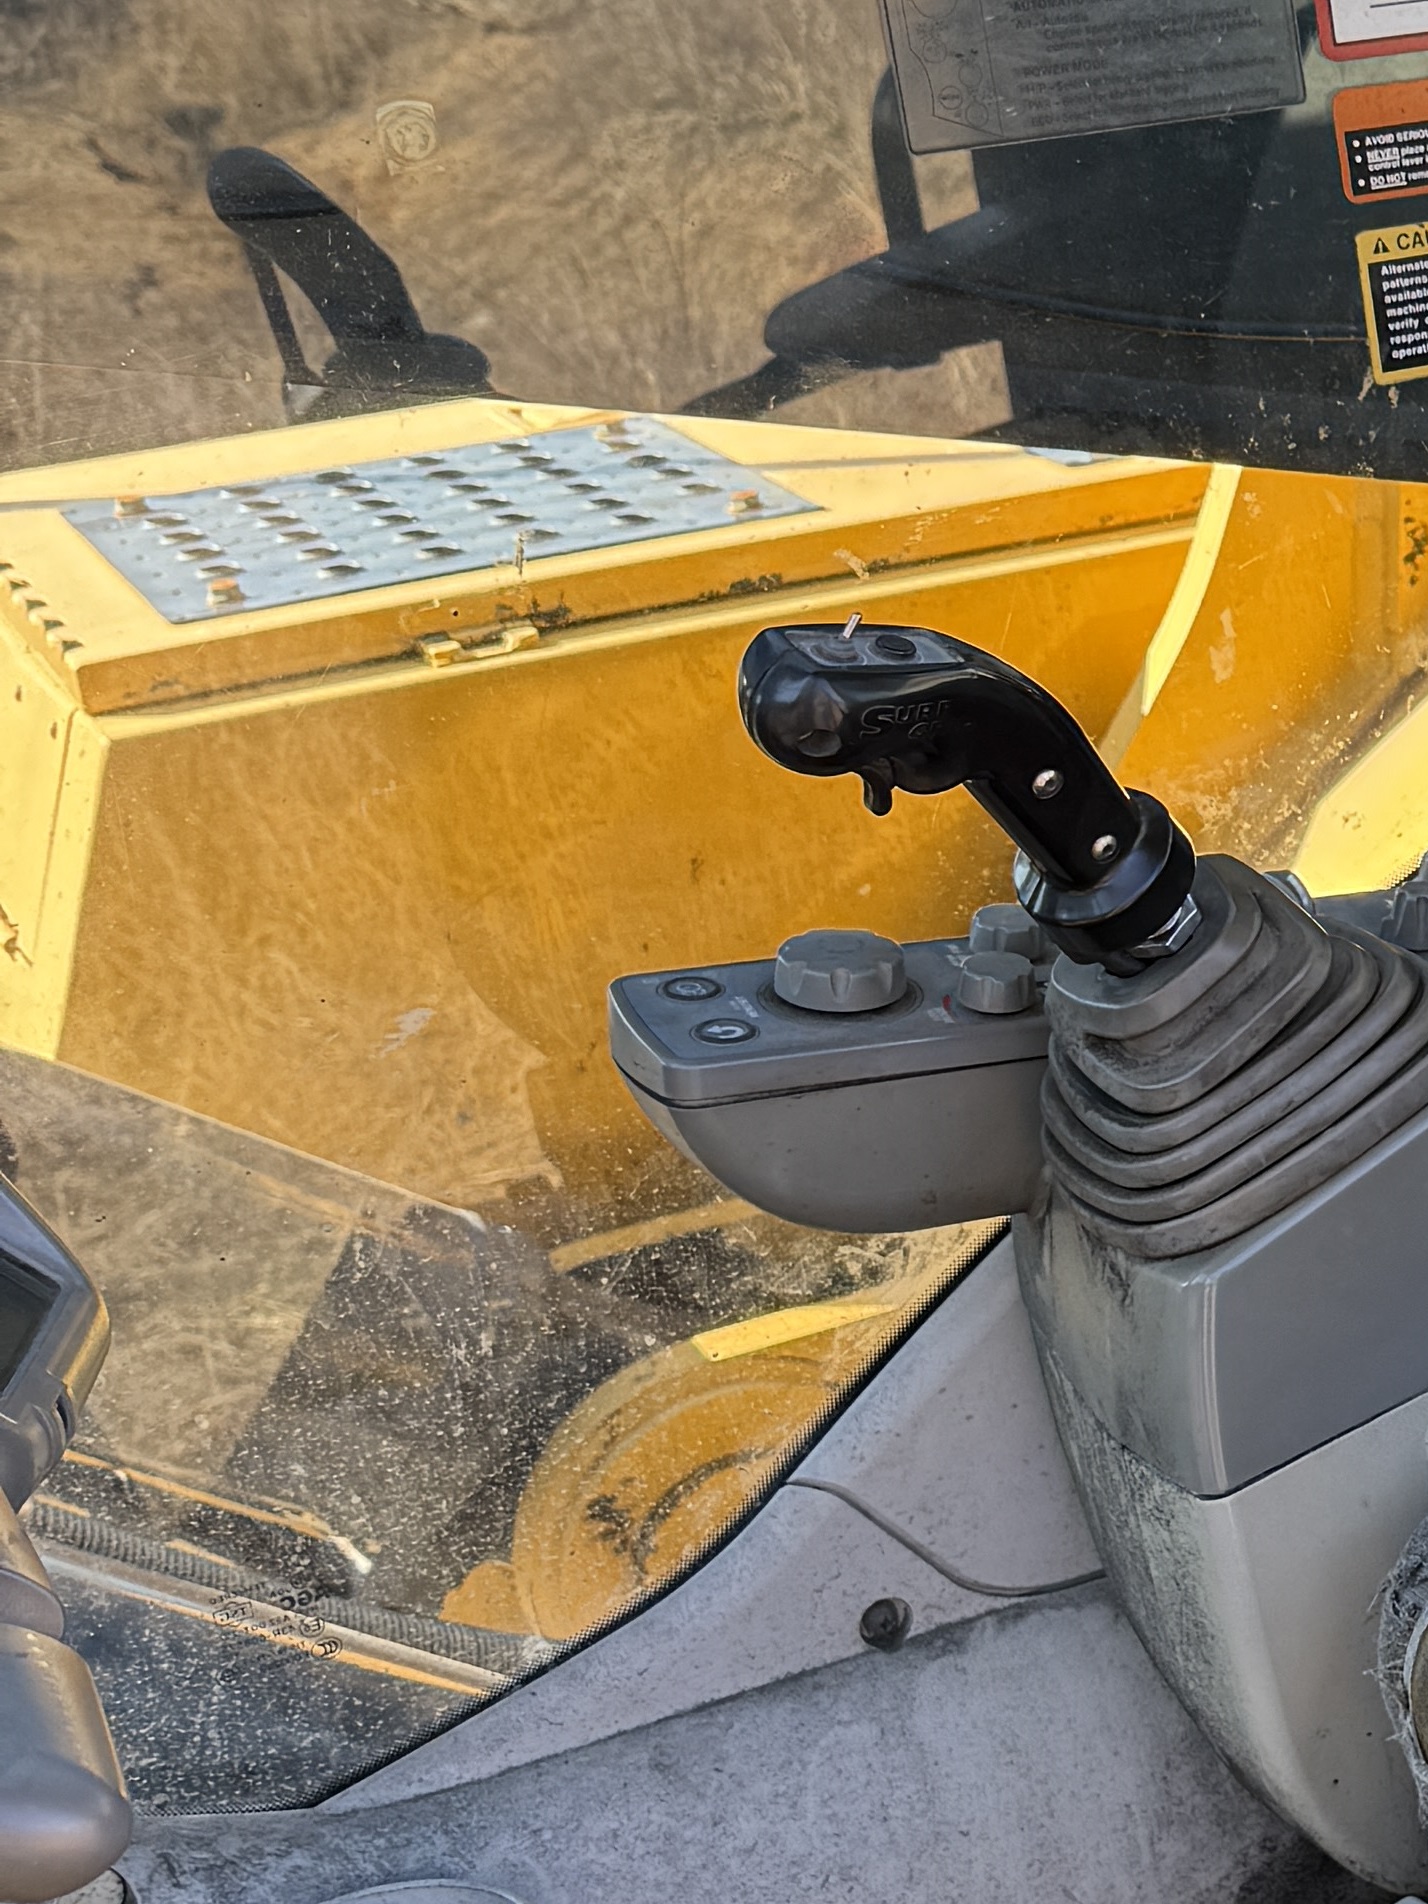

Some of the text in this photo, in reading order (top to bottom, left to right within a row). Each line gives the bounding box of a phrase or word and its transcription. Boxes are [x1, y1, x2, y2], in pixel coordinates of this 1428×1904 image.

[1364, 132, 1394, 147] AVOID
[1382, 274, 1428, 291] patterns
[1387, 316, 1419, 333] verify
